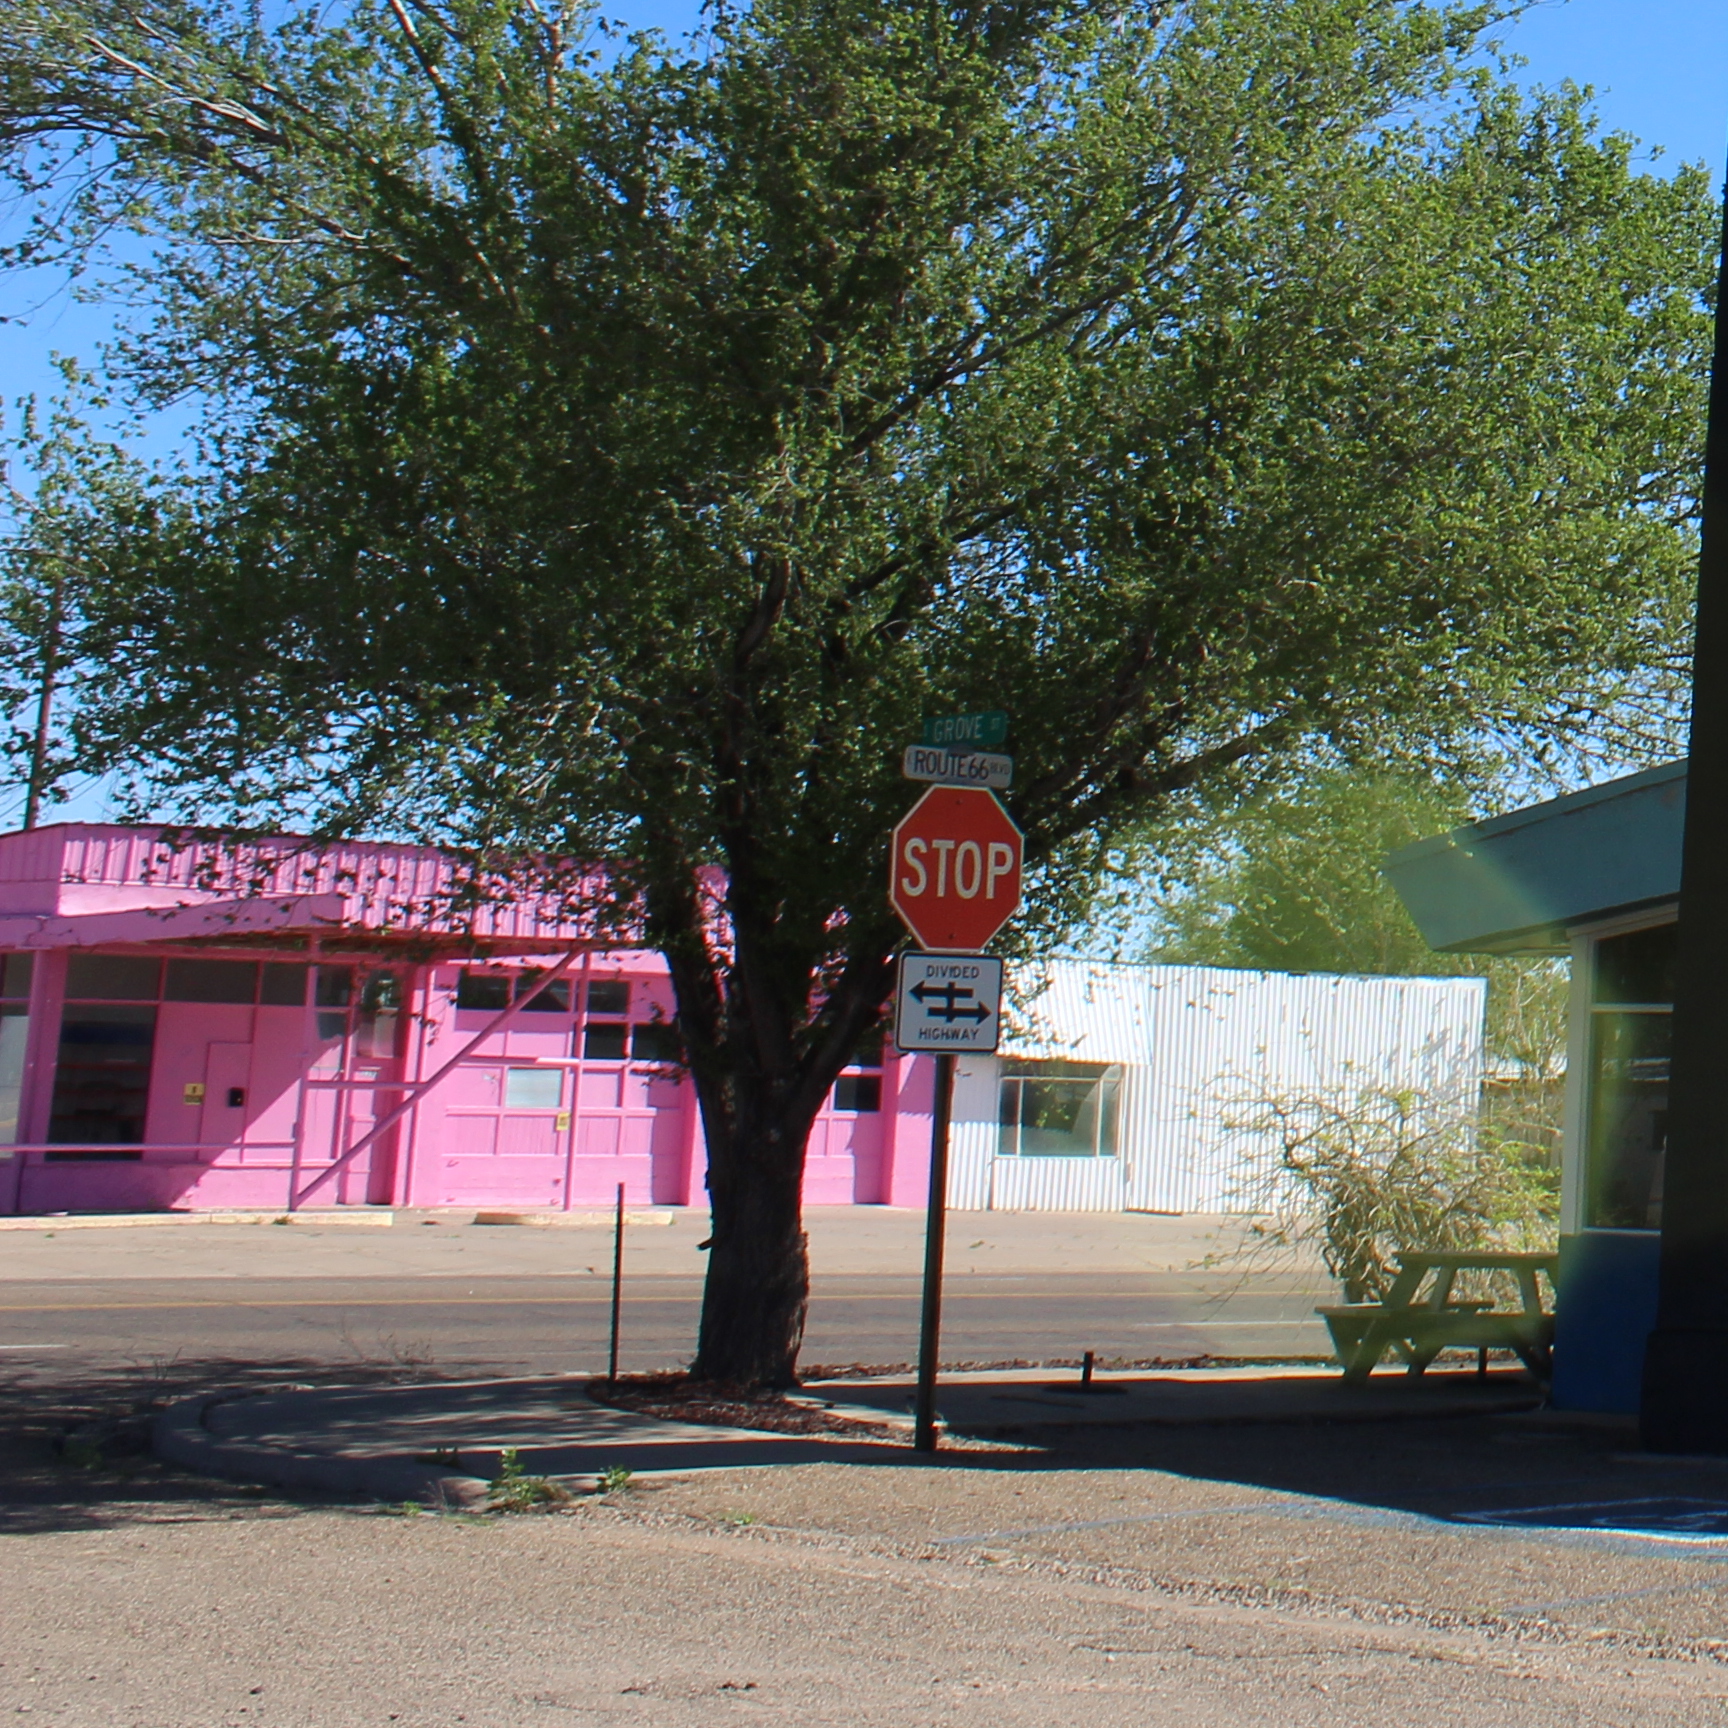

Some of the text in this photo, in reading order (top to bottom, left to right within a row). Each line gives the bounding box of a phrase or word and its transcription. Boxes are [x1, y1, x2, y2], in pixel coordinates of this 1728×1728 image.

[933, 715, 984, 743] GROVE
[914, 750, 966, 777] ROUTE
[968, 757, 989, 780] 66
[902, 837, 1014, 899] STOP
[926, 964, 980, 980] DIVIDED
[919, 1027, 980, 1041] HIGHWAY
